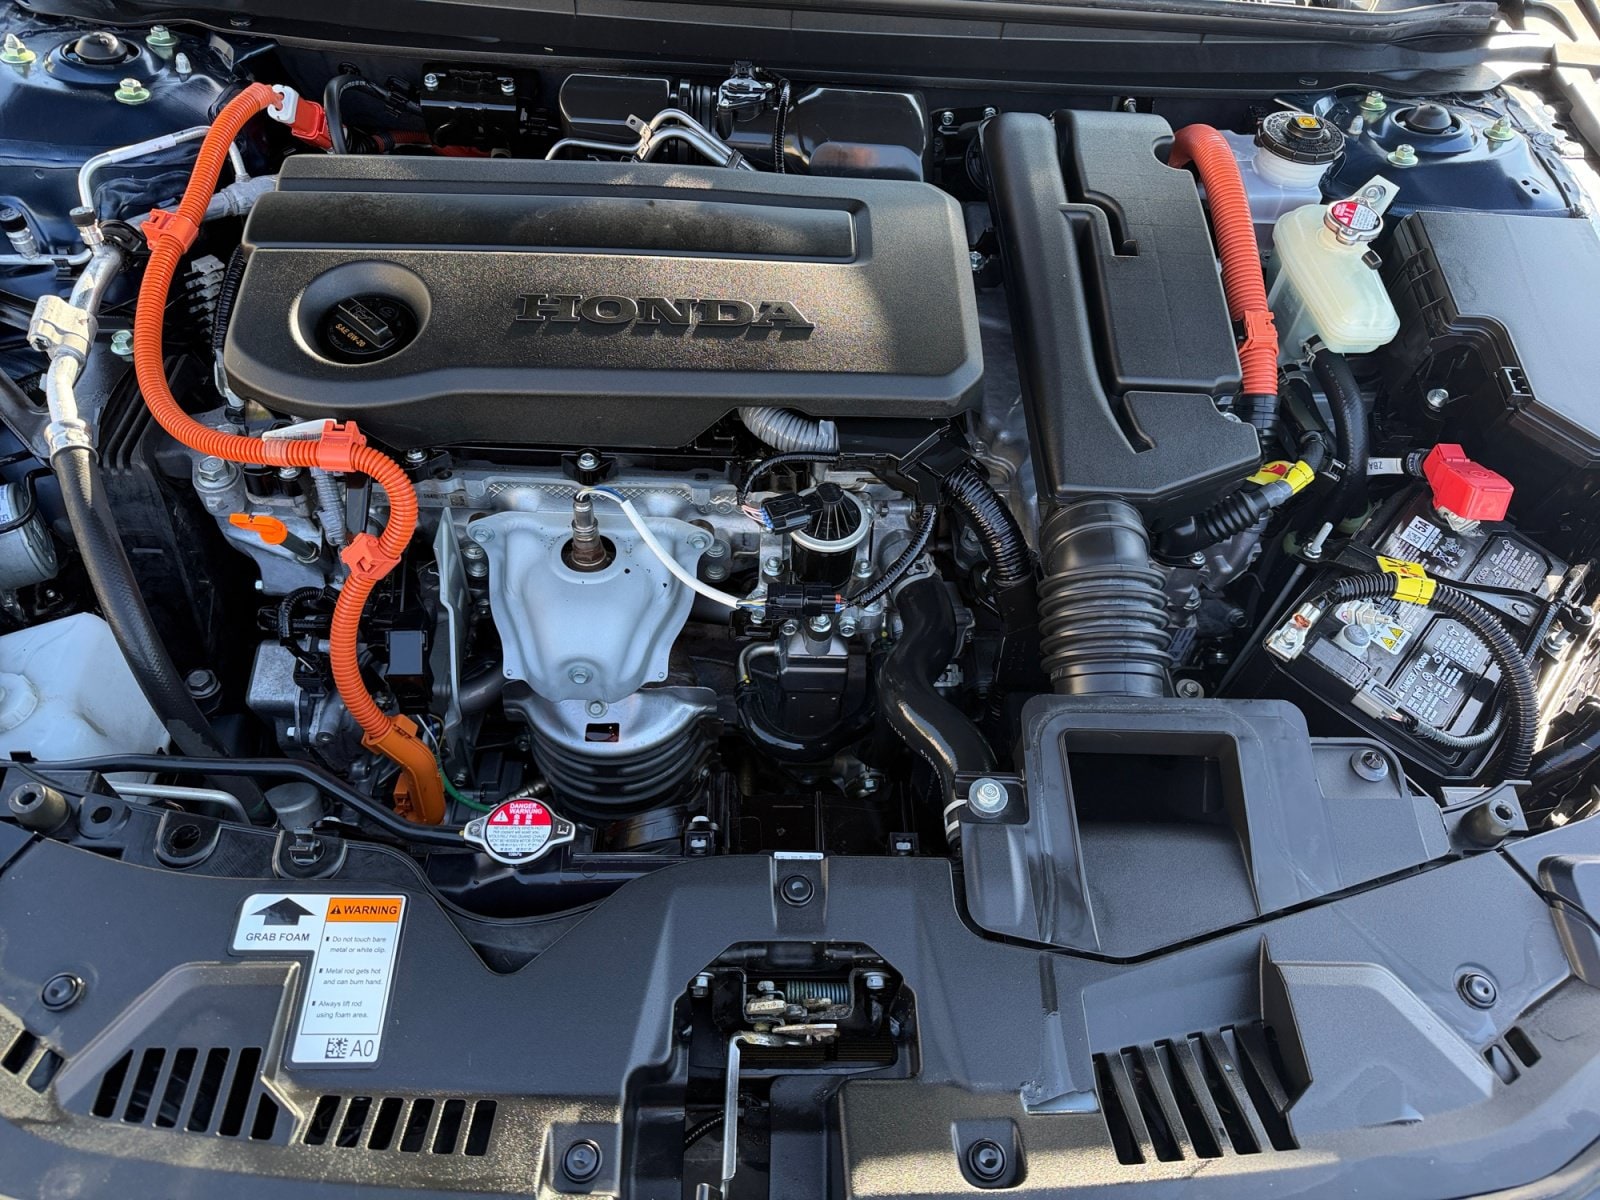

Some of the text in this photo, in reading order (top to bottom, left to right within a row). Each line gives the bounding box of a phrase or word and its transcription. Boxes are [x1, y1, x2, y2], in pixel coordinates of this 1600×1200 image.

[515, 293, 816, 328] HONDA
[335, 323, 350, 335] SAE
[1418, 521, 1431, 534] 5A
[343, 906, 398, 915] WARNING
[245, 932, 310, 942] GRAB FOAM
[373, 946, 386, 954] clip.
[325, 967, 381, 976] Metal rod gets hot
[318, 1000, 341, 1008] Always
[316, 1012, 333, 1020] using
